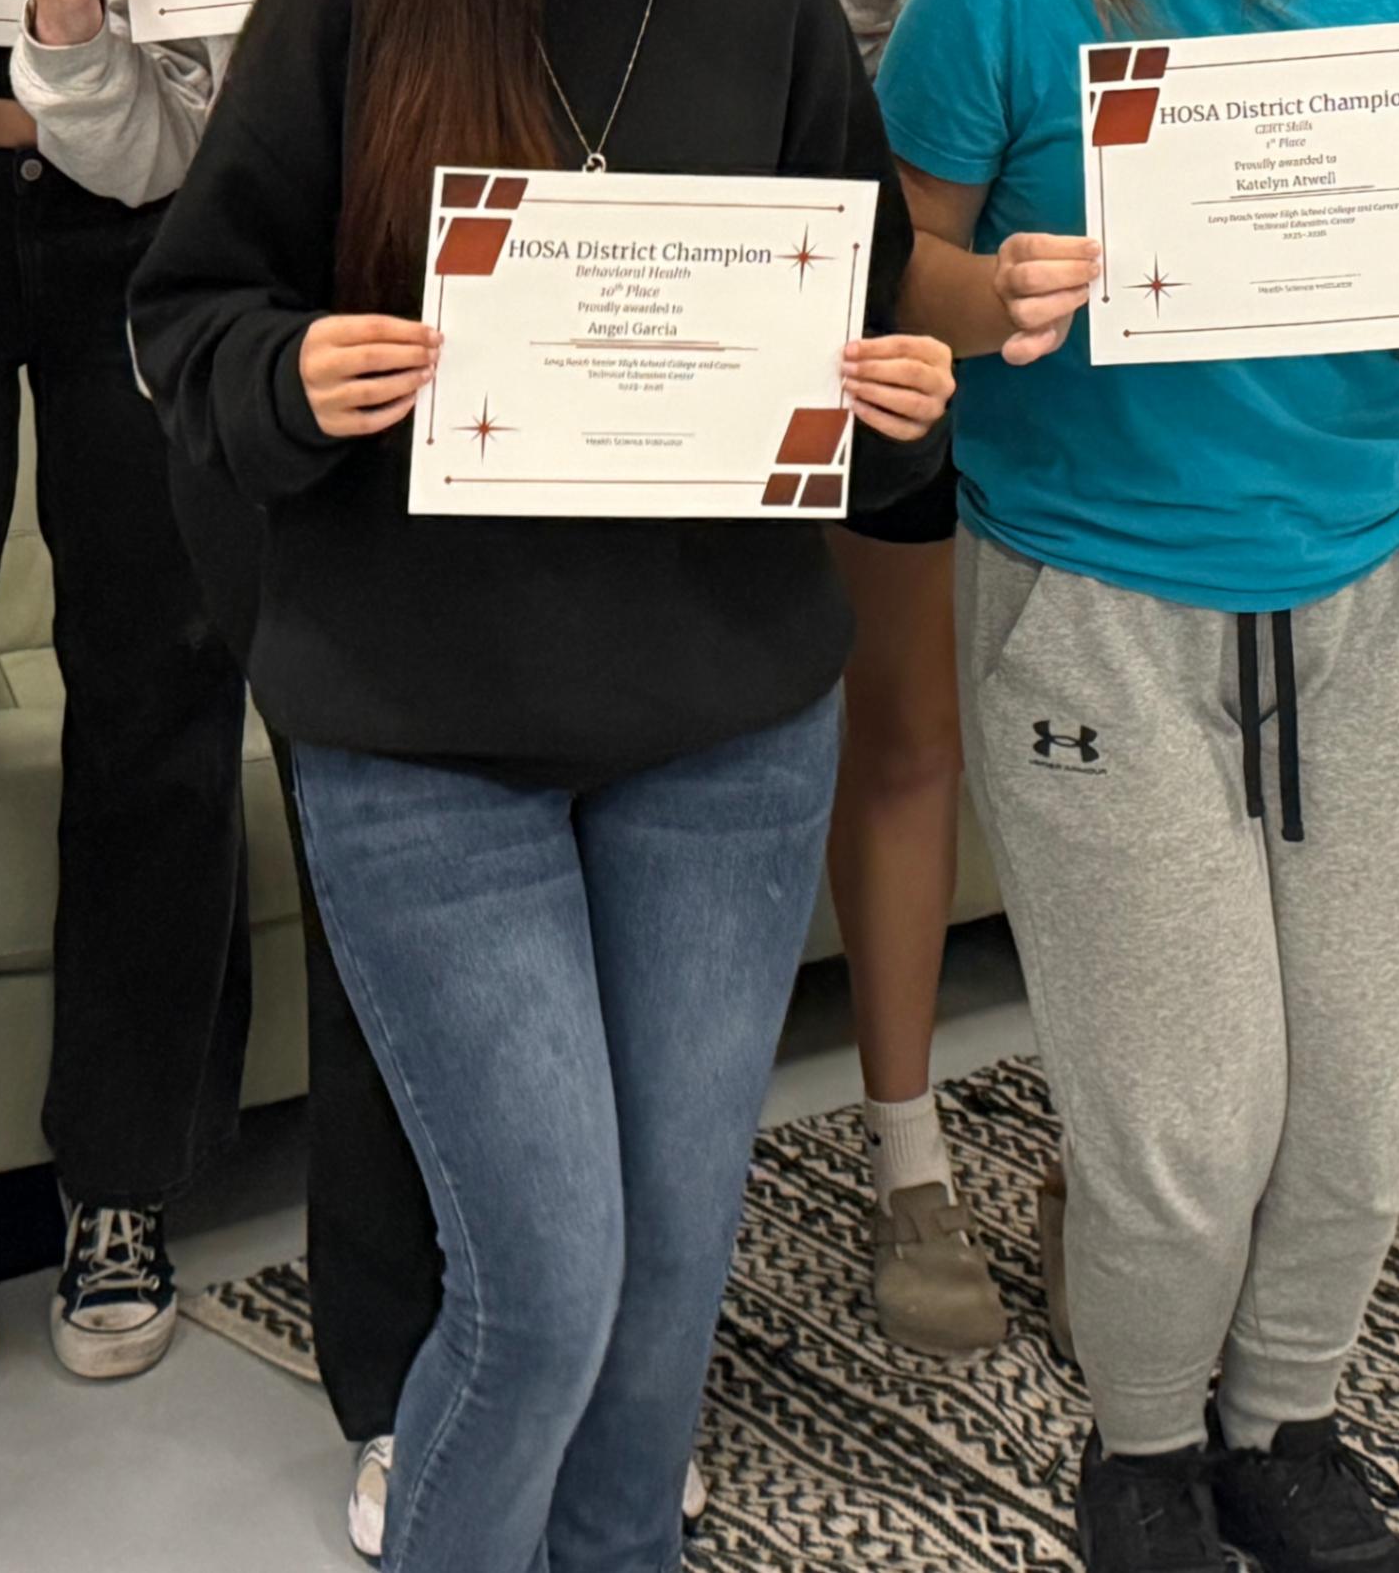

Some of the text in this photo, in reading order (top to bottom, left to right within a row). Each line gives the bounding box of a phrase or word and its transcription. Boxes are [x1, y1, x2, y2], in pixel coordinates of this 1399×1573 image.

[1160, 103, 1220, 124] HOSA
[1225, 98, 1303, 120] District
[1254, 120, 1313, 135] CERT Skills
[1234, 154, 1337, 171] Proudly awarded to
[1236, 171, 1336, 191] Katelyn Atwell
[508, 239, 771, 266] HOSA District Champion
[575, 265, 691, 279] Behavioral Health
[625, 284, 660, 298] Place
[577, 301, 683, 316] Proudly awarded to
[587, 321, 677, 338] Angel Garcia
